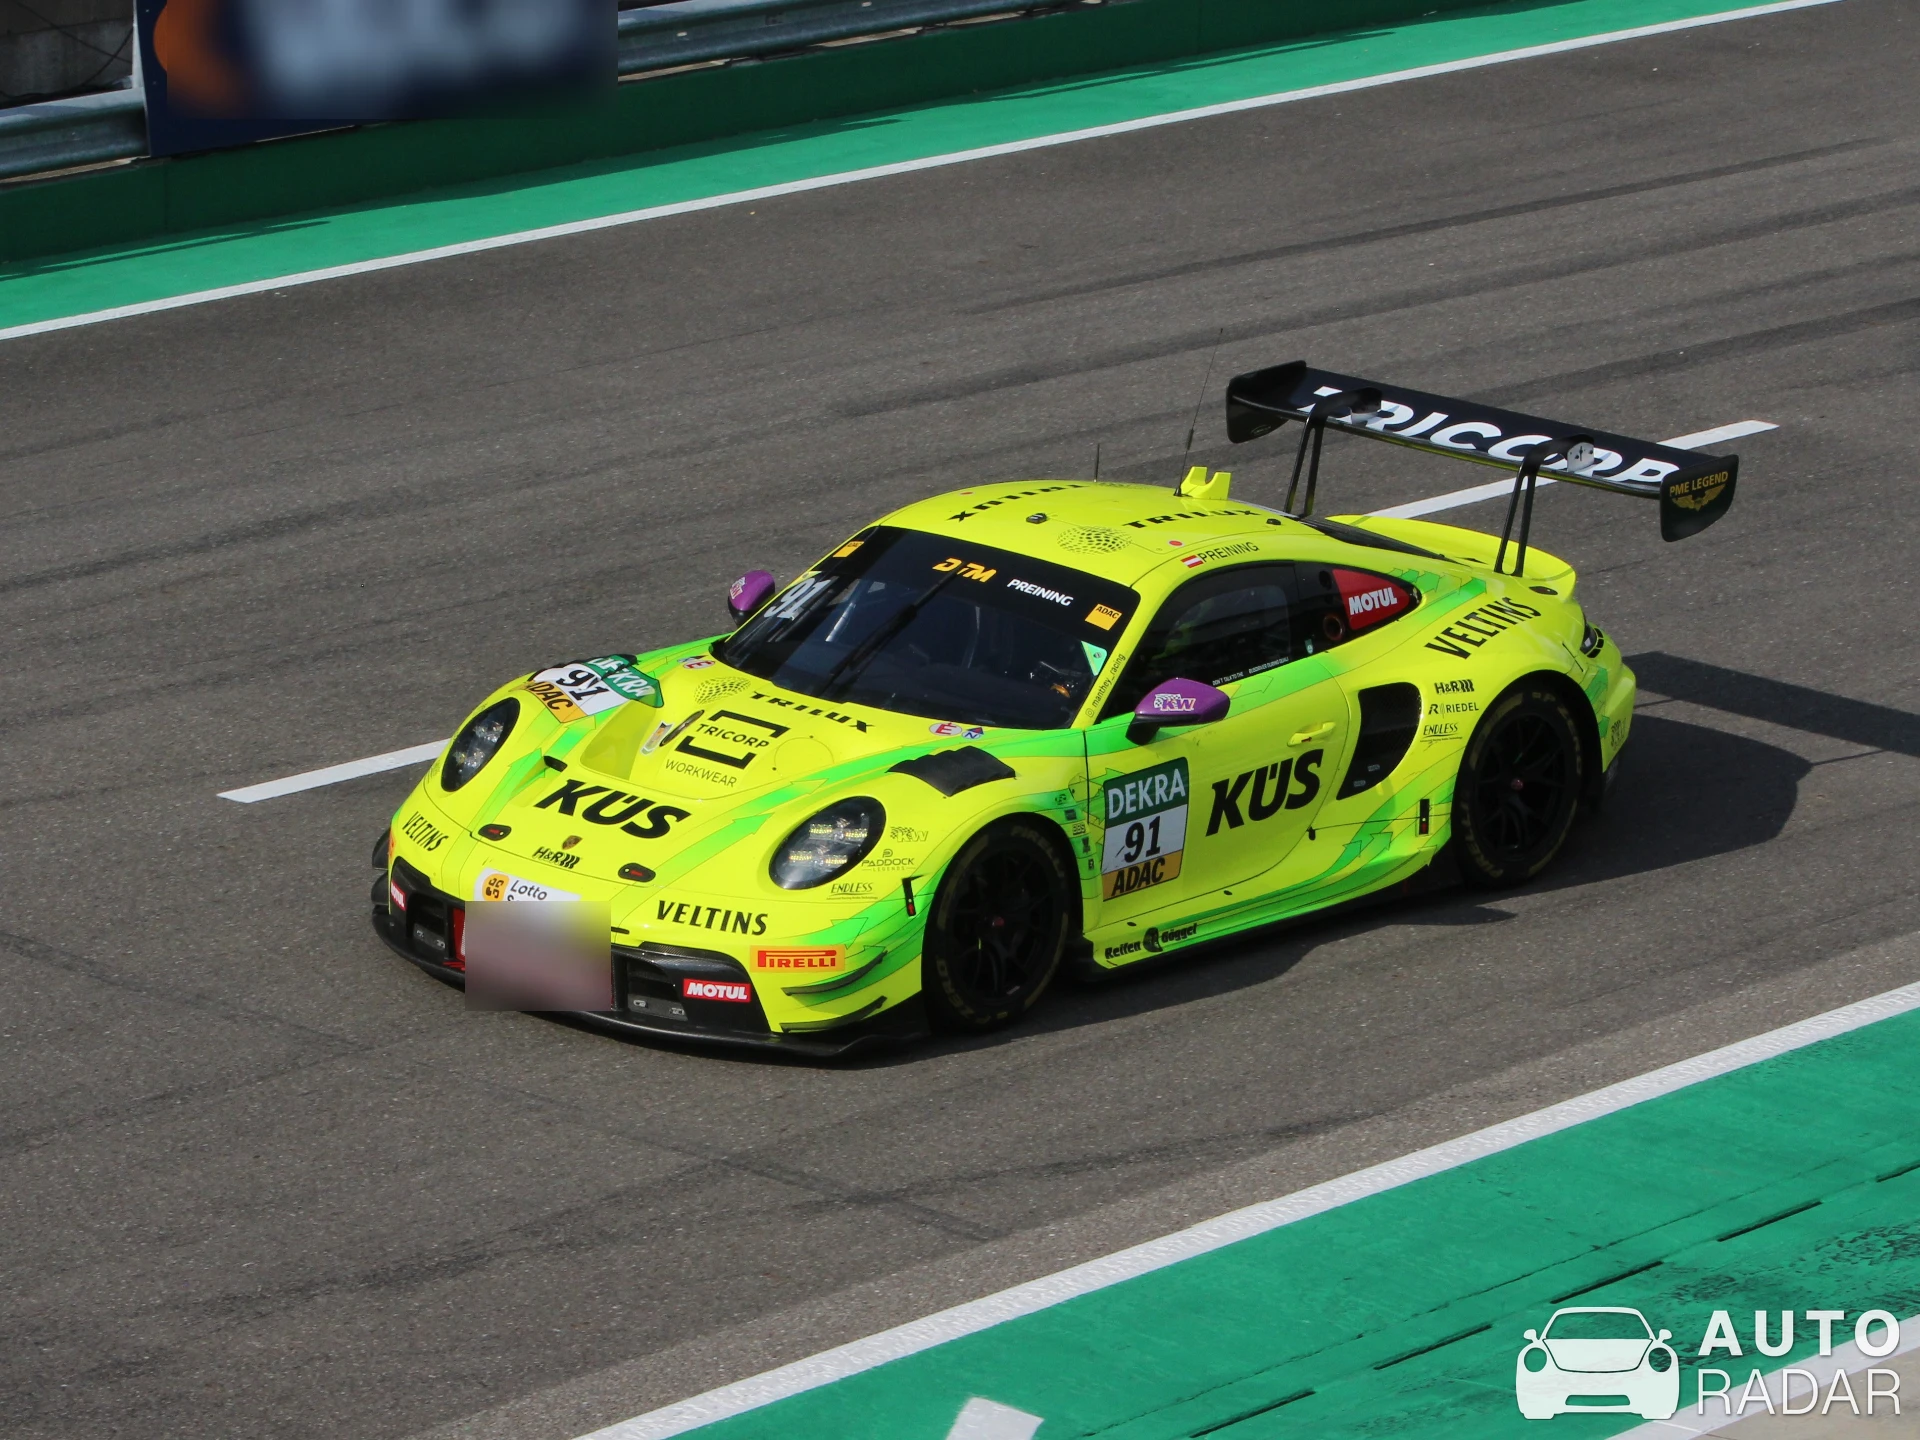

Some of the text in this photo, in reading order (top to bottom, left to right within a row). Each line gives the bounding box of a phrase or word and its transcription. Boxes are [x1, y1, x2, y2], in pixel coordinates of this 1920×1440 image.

[1669, 471, 1729, 497] PME LEGEND
[1122, 509, 1262, 529] TRILUX
[1198, 541, 1260, 564] PREINING
[932, 557, 997, 583] DTM
[763, 577, 832, 619] 91
[1006, 578, 1074, 607] PREINING
[1348, 586, 1398, 615] MOTUL
[1095, 605, 1119, 620] ADAC
[1424, 596, 1542, 660] VELTINS
[556, 669, 610, 700] 91
[1092, 653, 1126, 708] manthey_racing
[1434, 680, 1462, 694] H&R
[750, 691, 875, 734] TRILUX
[1158, 697, 1197, 711] KW
[1445, 702, 1480, 713] RIEDEL
[696, 723, 769, 749] TRICORP
[1423, 722, 1459, 736] ENDLESS
[665, 759, 737, 788] WORKWEAR
[1107, 768, 1186, 820] DEKRA
[1205, 748, 1324, 837] KÜS
[533, 778, 692, 839] KÜS
[401, 811, 449, 852] VELTINS
[1124, 815, 1161, 863] 91
[532, 846, 567, 866] H&R
[861, 857, 915, 867] PADDOCK
[510, 879, 548, 901] Lotto
[830, 882, 874, 894] ENDLESS
[1111, 857, 1166, 897] ADAC
[655, 899, 769, 937] VELTINS
[1104, 923, 1198, 959] Reifen Göggel
[757, 950, 837, 968] PIRELLI
[687, 982, 748, 1000] MOTUL
